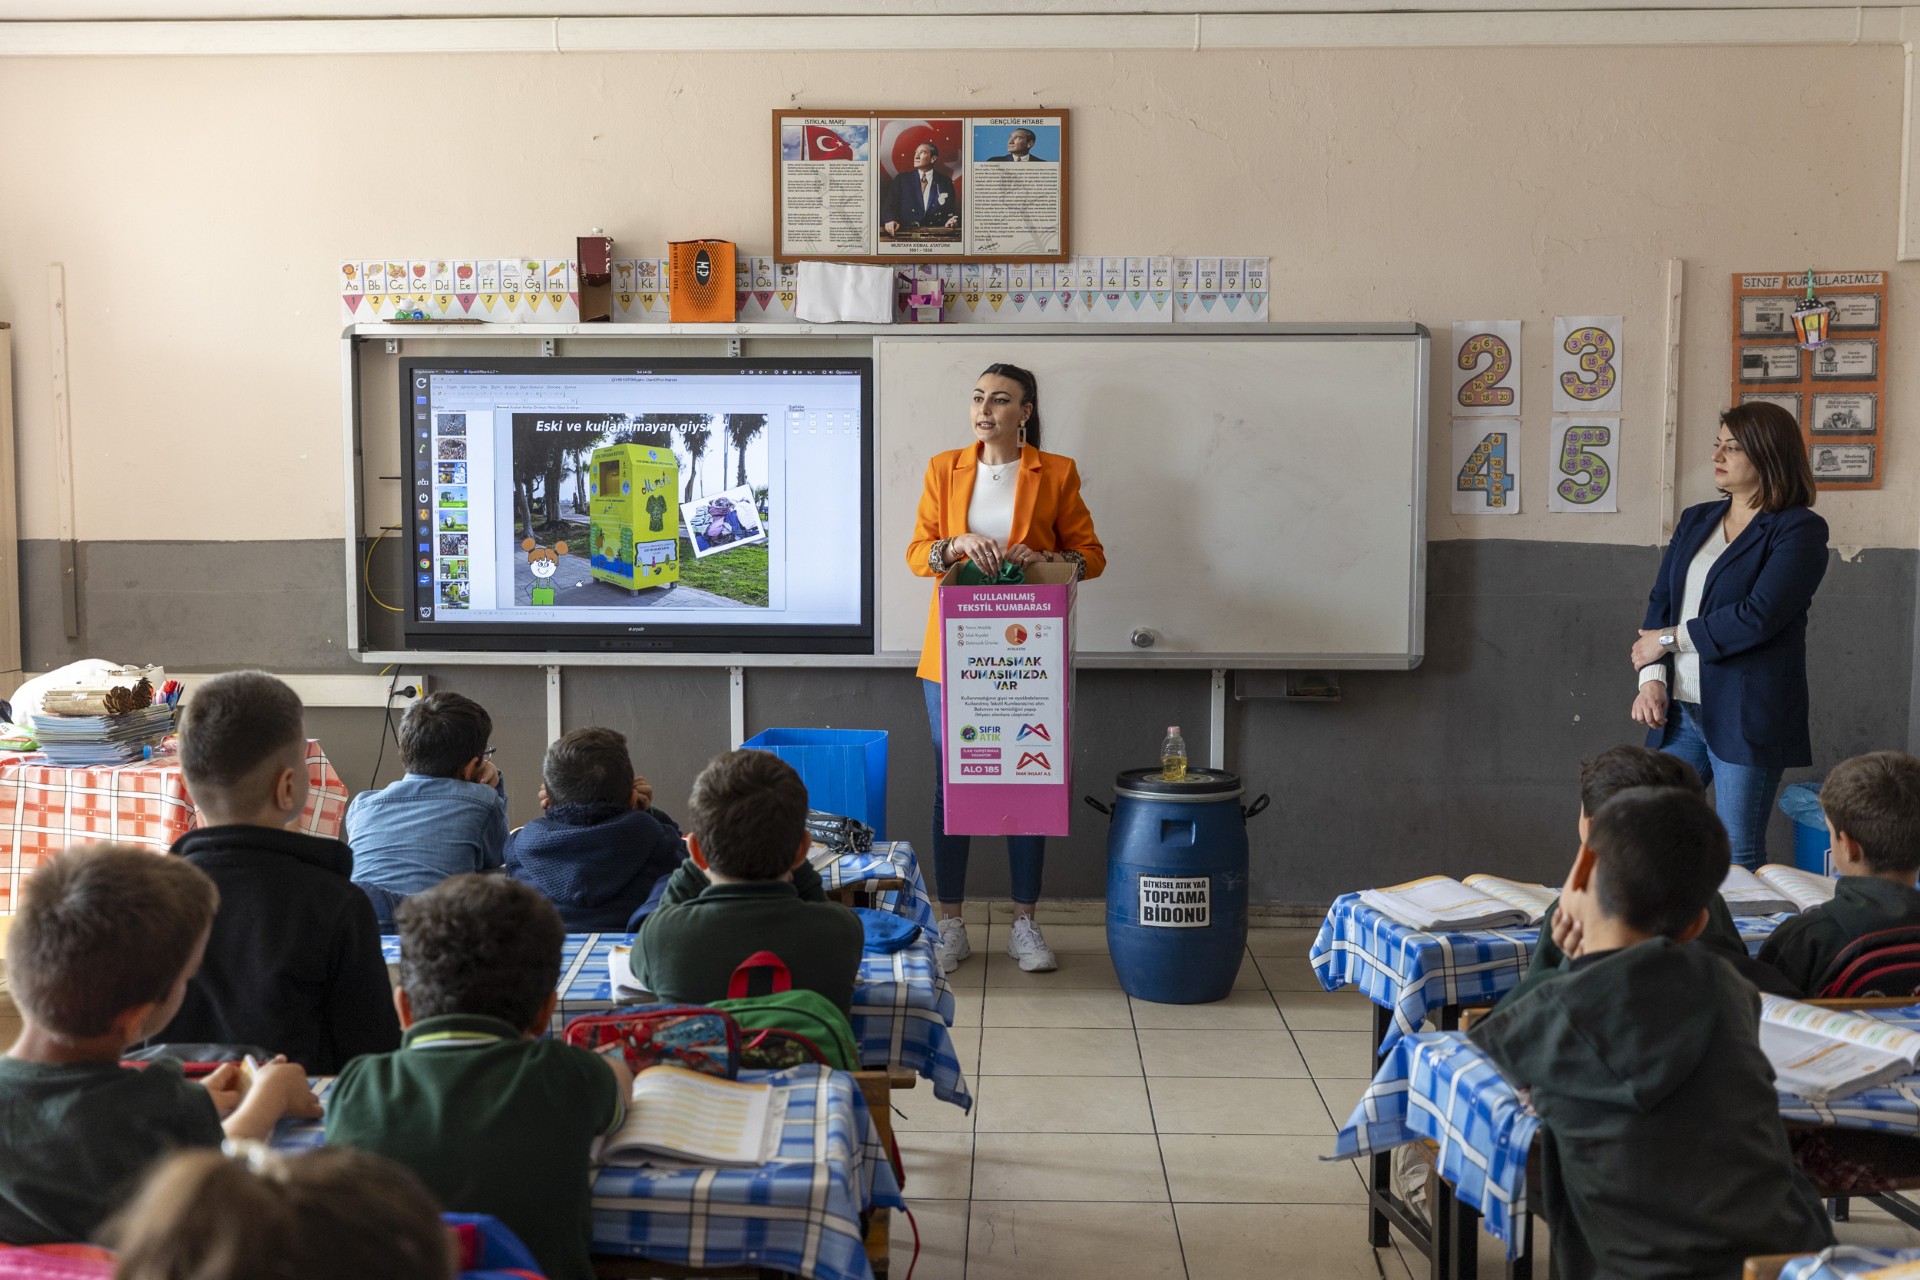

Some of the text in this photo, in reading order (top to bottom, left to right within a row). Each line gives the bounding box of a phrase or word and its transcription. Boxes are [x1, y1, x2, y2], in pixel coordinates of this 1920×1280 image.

[990, 118, 1021, 126] GENÇLİĞE
[345, 280, 359, 291] Aa
[368, 279, 381, 291] Bb
[389, 279, 403, 291] Cc
[412, 278, 427, 292] Çç
[435, 279, 449, 291] Dd
[459, 279, 471, 290] Ee
[482, 278, 494, 289] Ff
[503, 278, 518, 293] Gg
[524, 275, 540, 293] Ğğ
[549, 278, 563, 289] Hh
[619, 278, 628, 293] Jj
[641, 277, 653, 289] Kk
[756, 273, 772, 287] Öö
[781, 276, 793, 289] Pp
[965, 277, 979, 292] Yy
[989, 277, 1002, 288] Zz
[1015, 277, 1023, 287] 0
[1062, 277, 1070, 287] 2
[1086, 276, 1093, 287] 3
[1108, 276, 1116, 287] 4
[1133, 276, 1140, 287] 5
[1156, 276, 1163, 287] 6
[1181, 278, 1189, 288] 7
[1205, 278, 1212, 288] 8
[1229, 278, 1235, 288] 9
[1250, 278, 1261, 289] 10
[1743, 274, 1879, 288] SINIF KURALLARIMIZ
[372, 296, 379, 304] 2
[417, 294, 425, 302] 4
[441, 295, 447, 304] 5
[463, 295, 470, 304] 6
[486, 295, 493, 304] 7
[509, 294, 515, 303] 8
[531, 294, 537, 303] 9
[552, 294, 562, 303] 10
[620, 294, 630, 303] 13
[643, 294, 653, 303] 14
[759, 292, 769, 301] 19
[781, 292, 794, 301] 20
[943, 294, 955, 303] 27
[966, 293, 979, 302] 28
[990, 293, 1003, 303] 29
[1584, 332, 1590, 340] 6
[1598, 336, 1604, 344] 9
[1472, 343, 1478, 351] 4
[1497, 347, 1503, 356] 8
[1560, 327, 1616, 401] 3
[1588, 358, 1596, 366] 15
[1458, 333, 1514, 407] 2
[1565, 376, 1574, 384] 30
[1474, 382, 1482, 390] 14
[1589, 386, 1597, 394] 24
[1464, 393, 1472, 401] 16
[1499, 393, 1508, 401] 20
[535, 420, 563, 432] Eski
[566, 422, 582, 432] ve
[585, 420, 675, 434] kullanılmayan
[1583, 432, 1592, 440] 10
[1483, 443, 1489, 451] 8
[1475, 454, 1483, 462] 12
[1457, 432, 1514, 506] 4
[1557, 426, 1610, 504] 5
[973, 592, 1036, 603] KULLANILMIŞ
[957, 602, 1051, 612] TEKSTİL KUMBARASI
[994, 681, 1018, 690] VAR
[979, 726, 1001, 734] SIFIR
[979, 733, 1001, 741] ATIK
[1143, 880, 1206, 889] BİTKİSEL ATIK YAĞ
[1143, 890, 1206, 904] TOPLAMA
[1143, 904, 1206, 923] BİDONU
